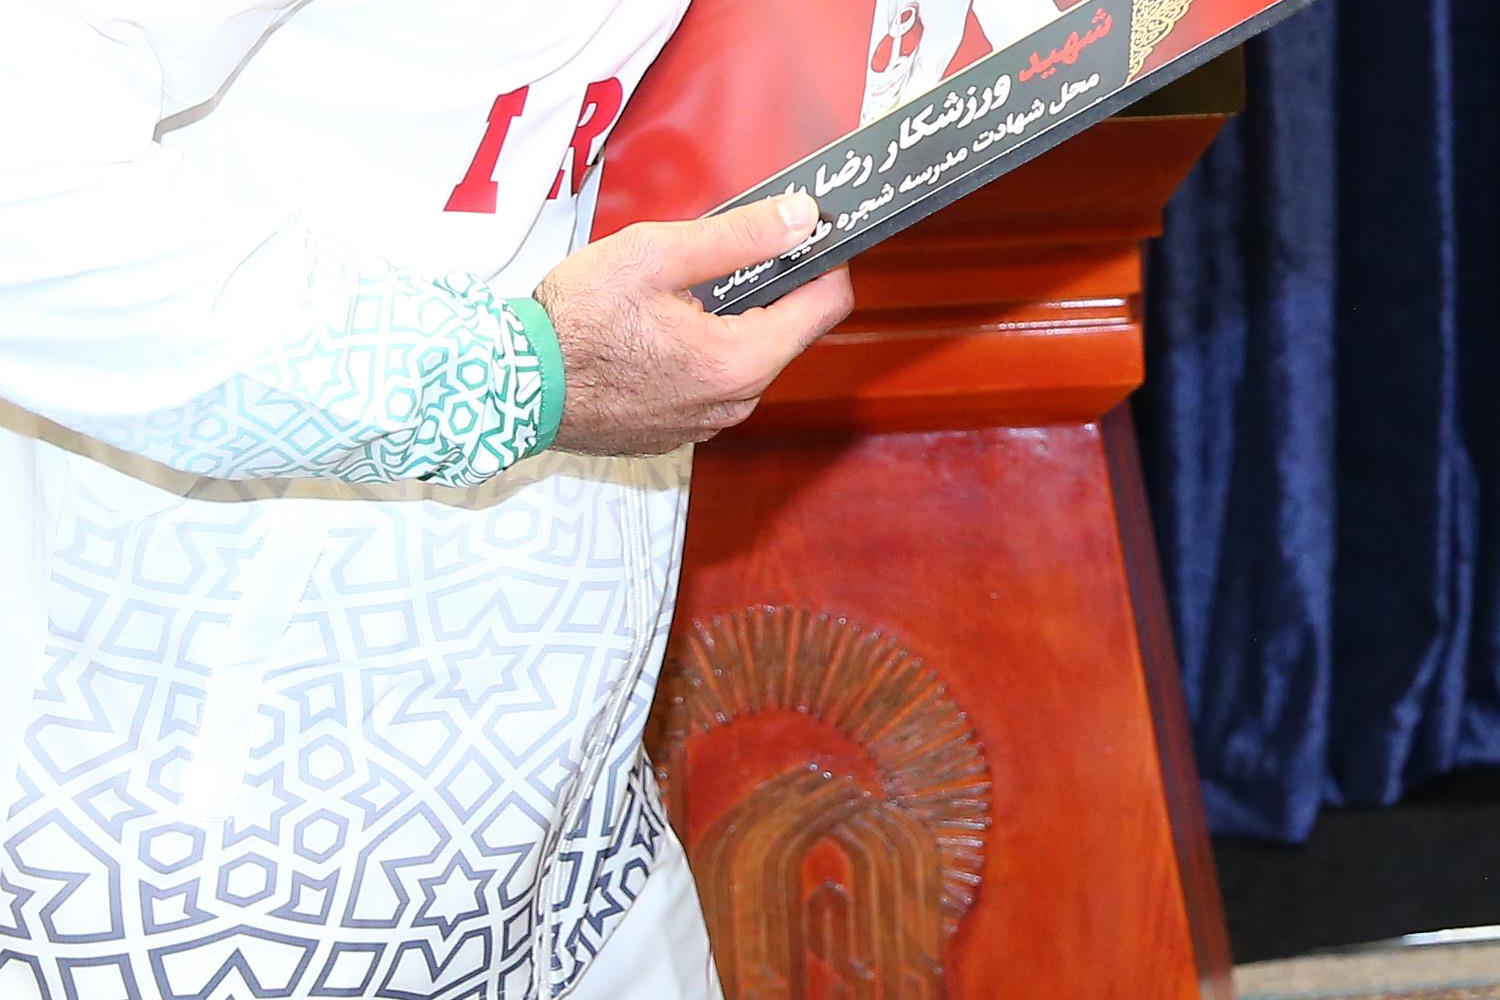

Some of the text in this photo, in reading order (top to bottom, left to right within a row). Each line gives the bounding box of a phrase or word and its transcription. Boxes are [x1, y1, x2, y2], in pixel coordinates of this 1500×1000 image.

[815, 8, 1113, 197] شهید ورزشکار رضا
[1049, 73, 1100, 114] محل
[972, 99, 1045, 152] شهادت
[899, 148, 968, 192] مدرسه
[837, 183, 895, 231] شجره
